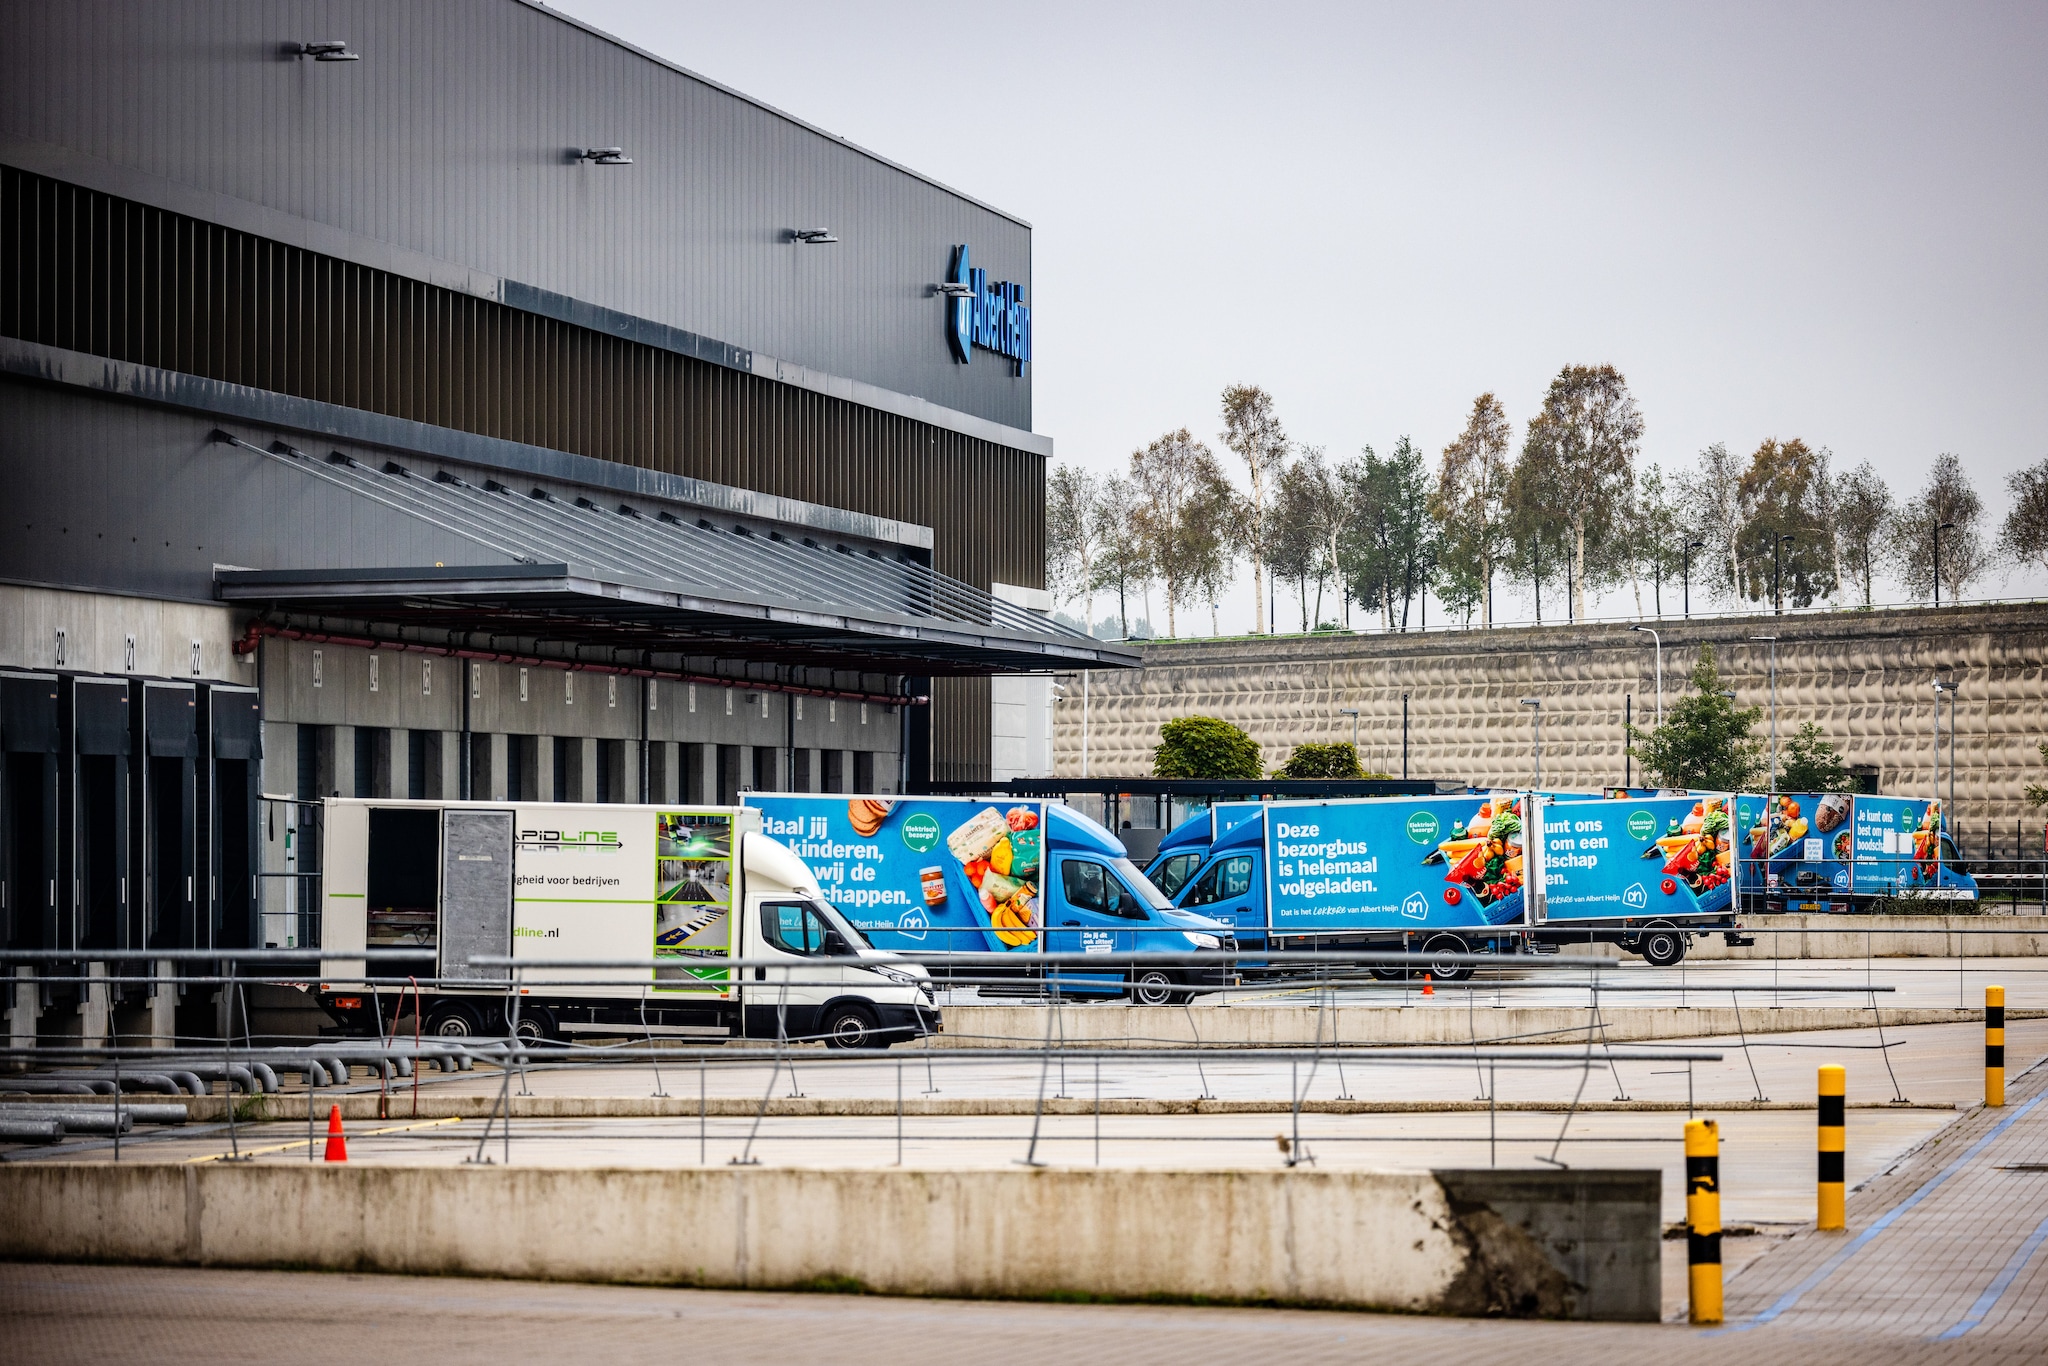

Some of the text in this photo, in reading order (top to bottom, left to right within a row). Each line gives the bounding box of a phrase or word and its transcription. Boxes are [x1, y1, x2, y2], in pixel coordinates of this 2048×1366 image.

[971, 267, 1005, 355] Albert
[56, 631, 66, 666] 20
[126, 637, 135, 671] 21
[192, 643, 201, 676] 22
[1409, 821, 1437, 829] Elektrisch
[1857, 809, 1866, 821] Je
[1867, 809, 1881, 822] kunt
[1882, 812, 1893, 823] ons
[760, 816, 828, 840] Haal jij
[905, 825, 937, 833] Elektrisch
[1277, 823, 1320, 839] Deze
[1544, 819, 1603, 834] unt ons
[1857, 823, 1871, 836] best
[1872, 826, 1882, 837] om
[789, 838, 884, 864] kinderen,
[1277, 838, 1368, 859] bezorgbus
[1550, 839, 1575, 851] om
[1579, 837, 1609, 849] een
[814, 862, 876, 885] wij de
[1228, 857, 1252, 875] do
[1279, 856, 1378, 877] is helemaal
[547, 877, 570, 885] voor
[572, 875, 620, 887] bedrijven
[1279, 876, 1378, 899] volgeladen.
[1586, 895, 1605, 903] Albert
[1606, 894, 1620, 902] Heijn
[1294, 908, 1299, 916] is
[1300, 908, 1312, 916] het
[1360, 905, 1381, 913] Albert
[1382, 904, 1399, 913] Heijn
